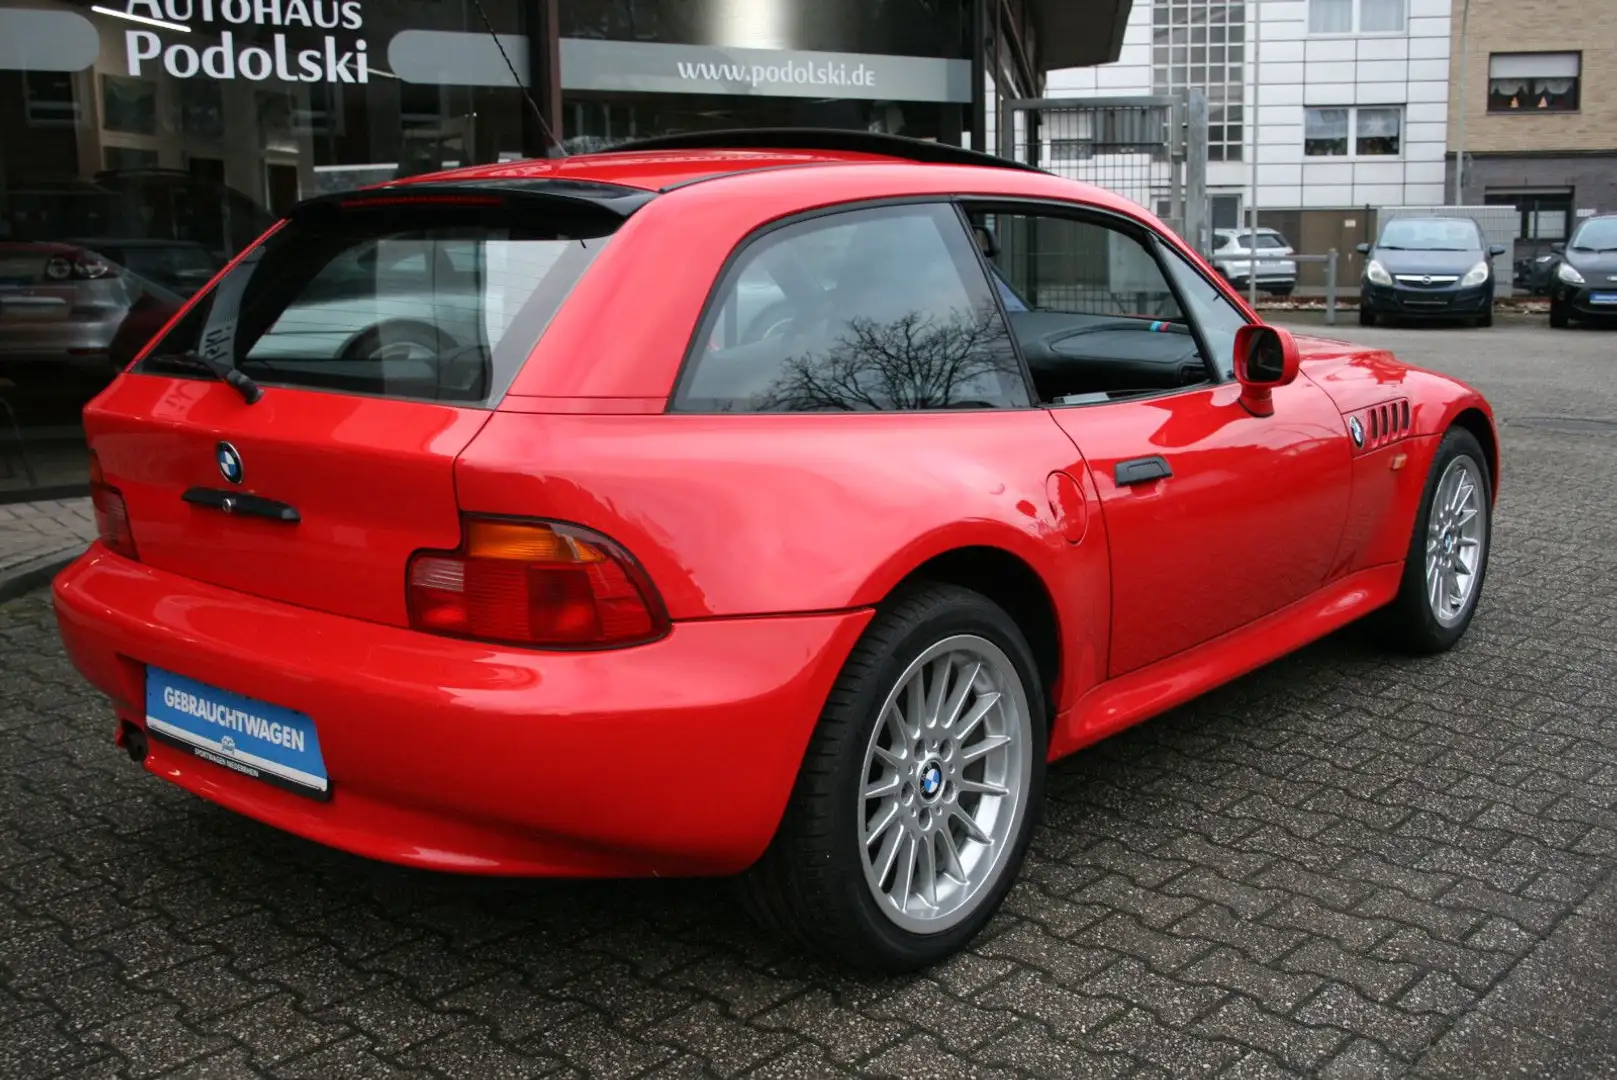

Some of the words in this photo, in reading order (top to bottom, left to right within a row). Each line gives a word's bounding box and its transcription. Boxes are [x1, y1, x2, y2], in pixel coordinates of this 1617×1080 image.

[125, 30, 369, 83] Podolski
[677, 60, 875, 87] www.podolski.de
[164, 687, 304, 752] GEBRAUCHTWAGEN
